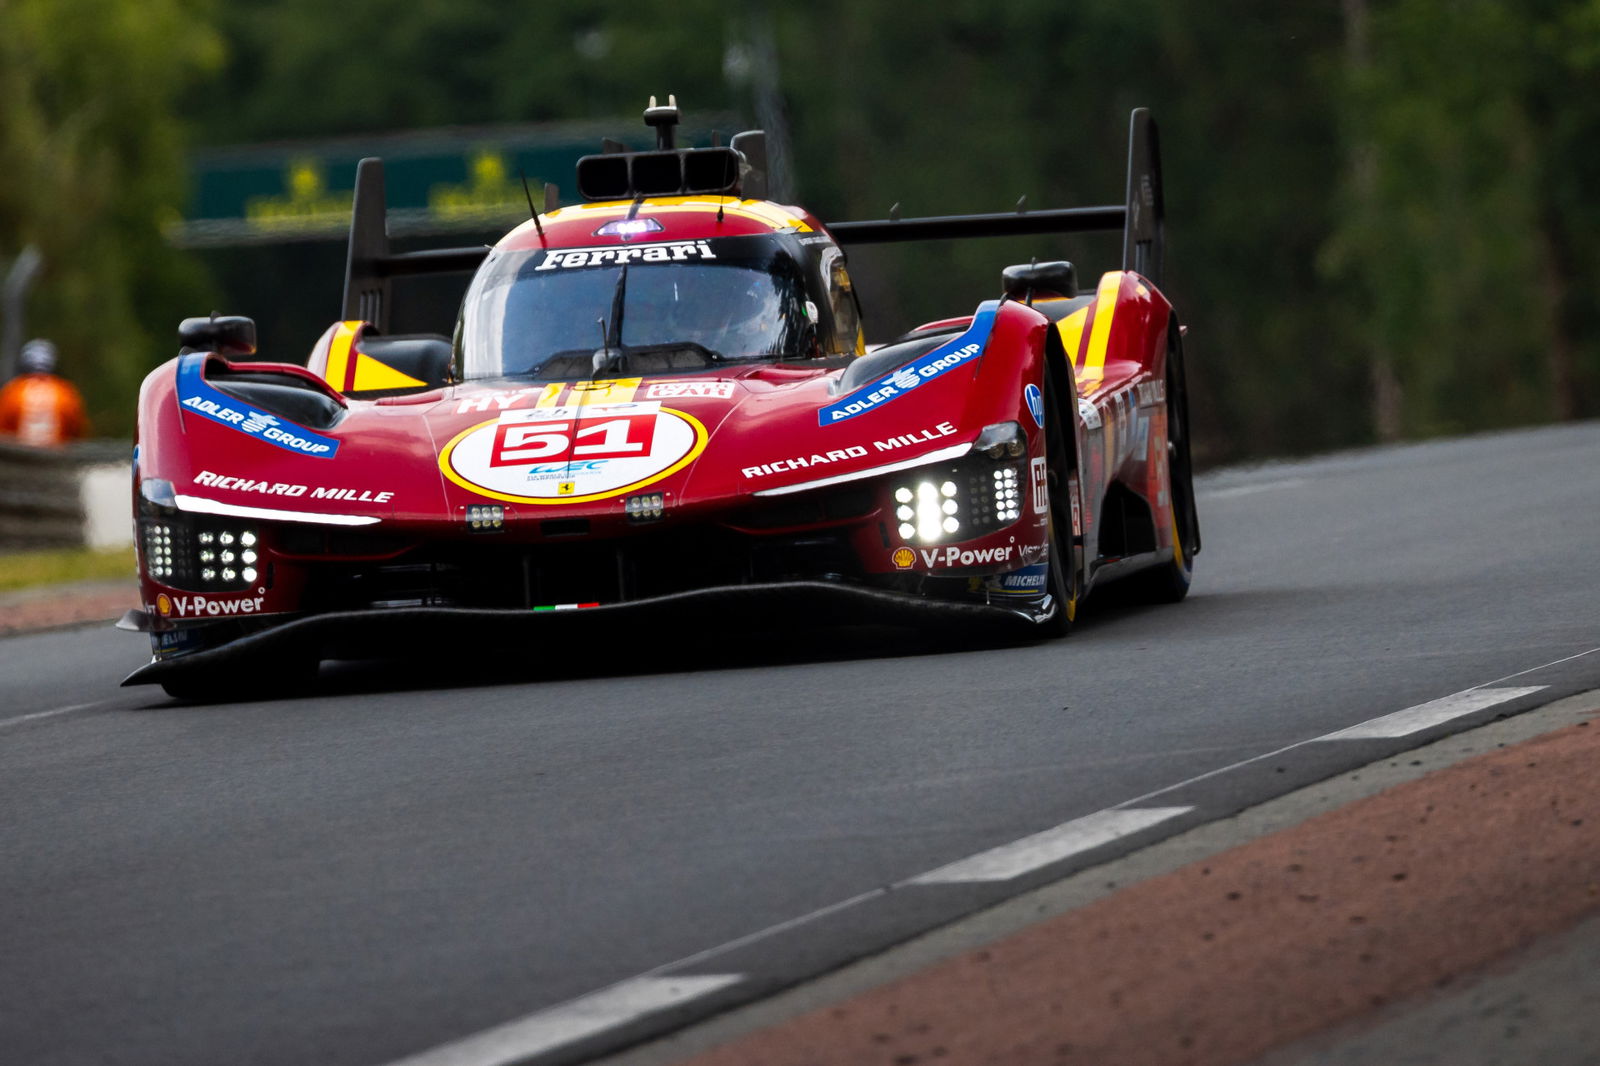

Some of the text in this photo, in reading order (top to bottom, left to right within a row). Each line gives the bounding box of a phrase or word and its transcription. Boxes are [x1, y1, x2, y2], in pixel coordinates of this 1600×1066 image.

[534, 240, 717, 271] Ferrari
[830, 342, 981, 421] ADLER GROUP
[181, 396, 331, 454] ADLER GROUP
[499, 418, 645, 462] 51
[741, 421, 958, 479] RICHARD MILLE
[193, 470, 395, 503] RICHARD MILLE
[920, 546, 1013, 569] V-Power
[173, 596, 264, 616] V-Power
